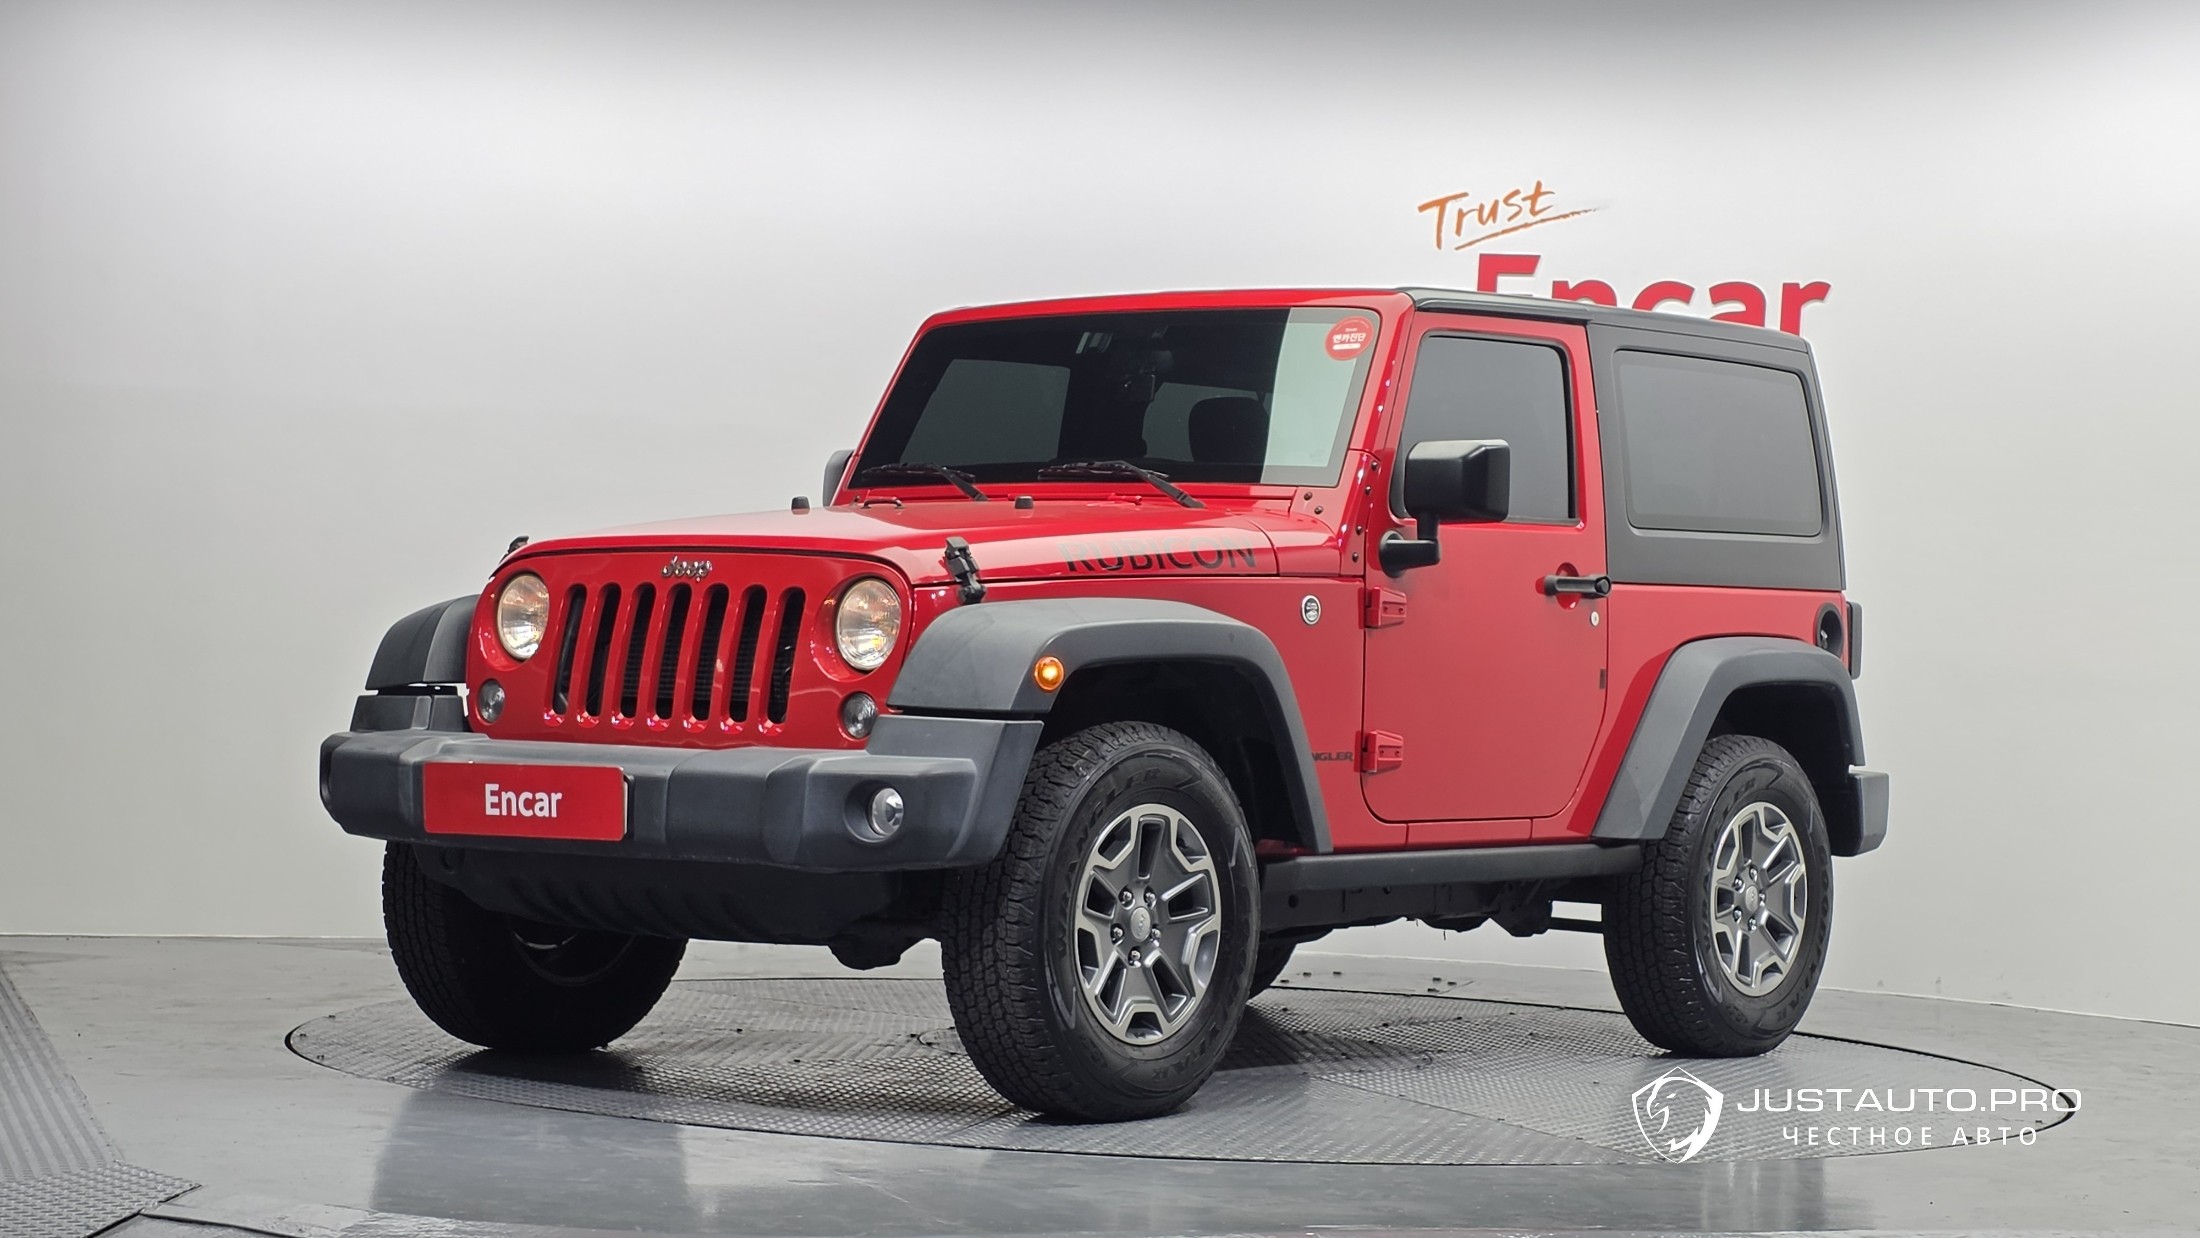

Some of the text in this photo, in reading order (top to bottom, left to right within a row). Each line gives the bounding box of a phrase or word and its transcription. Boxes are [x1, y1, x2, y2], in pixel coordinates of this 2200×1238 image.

[1418, 180, 1555, 250] Trust
[661, 555, 713, 582] Jeep
[1058, 536, 1256, 571] RUBICON
[484, 783, 562, 818] Encar
